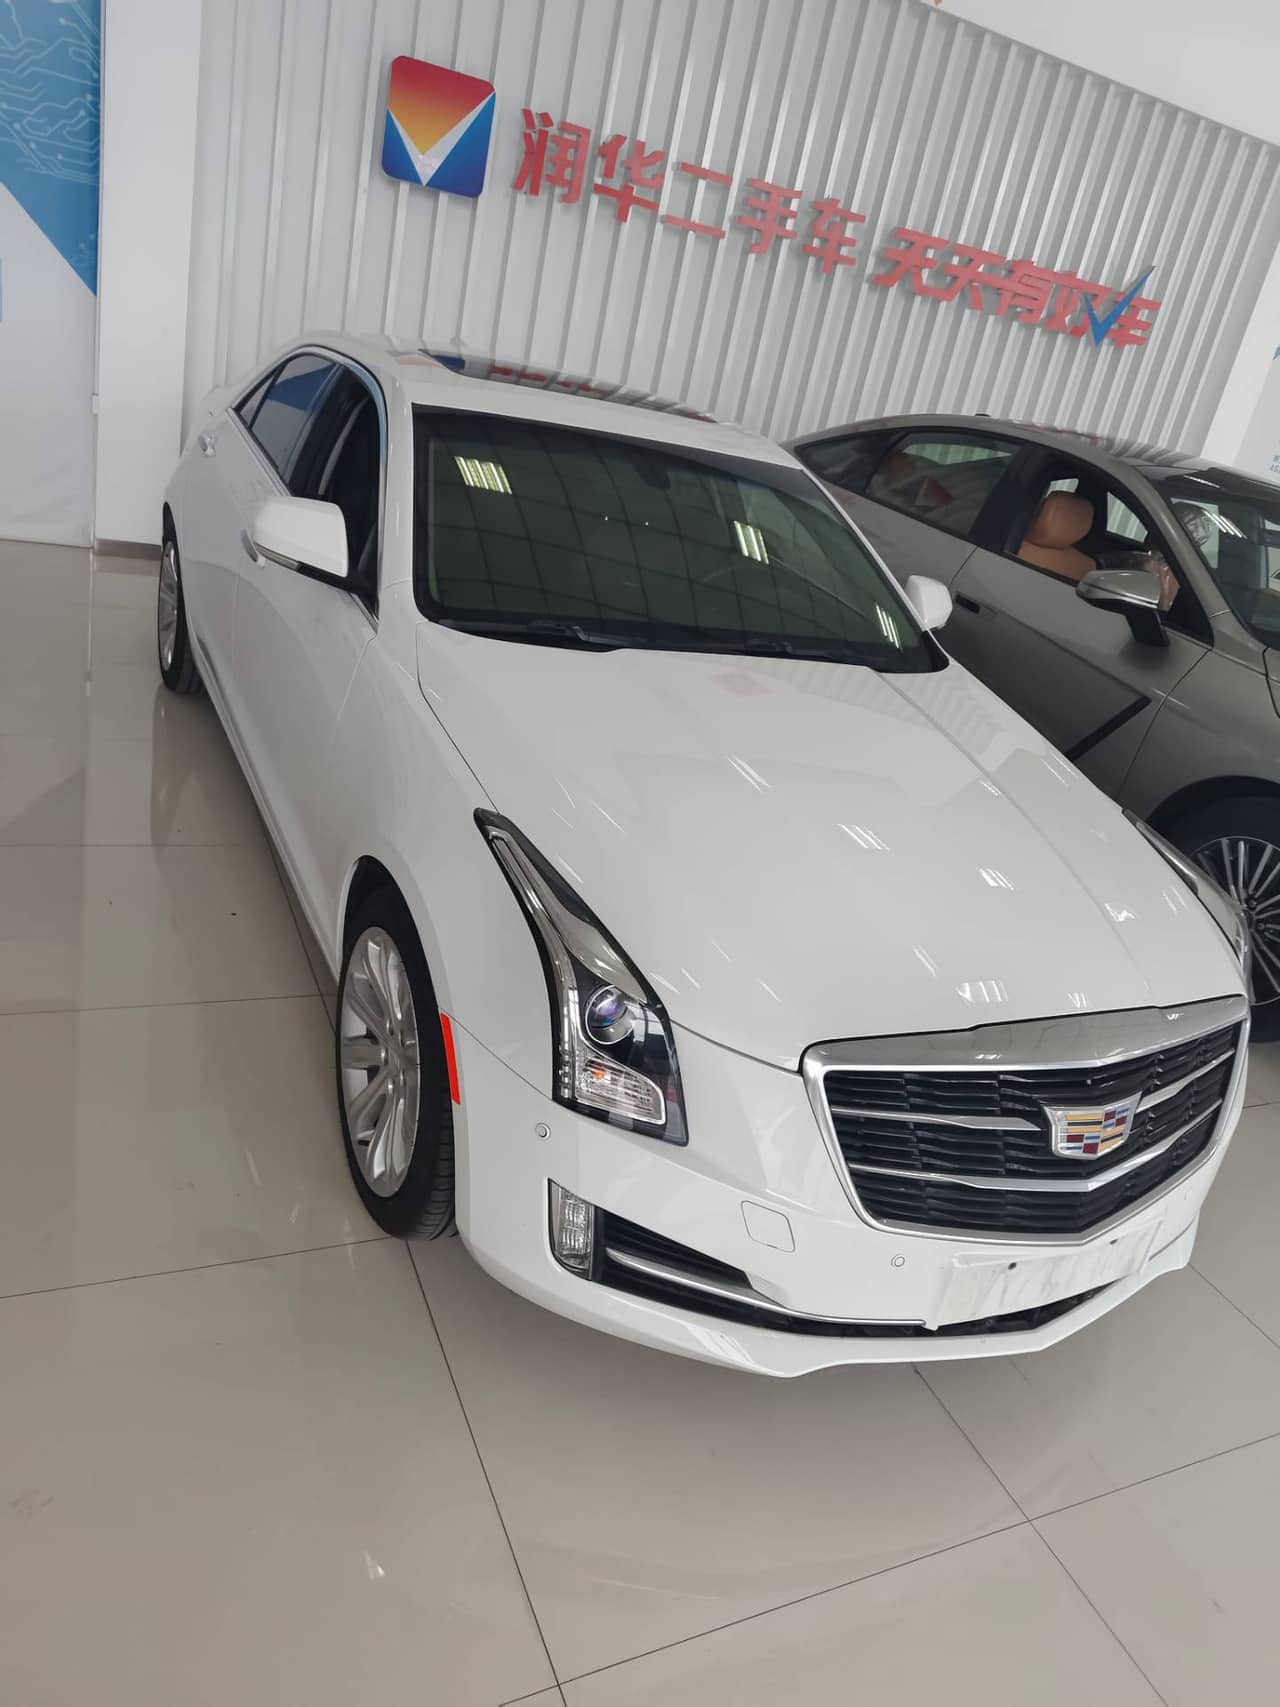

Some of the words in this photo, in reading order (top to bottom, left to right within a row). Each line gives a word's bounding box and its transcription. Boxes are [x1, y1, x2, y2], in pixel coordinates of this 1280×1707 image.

[512, 108, 866, 275] 润华二手车
